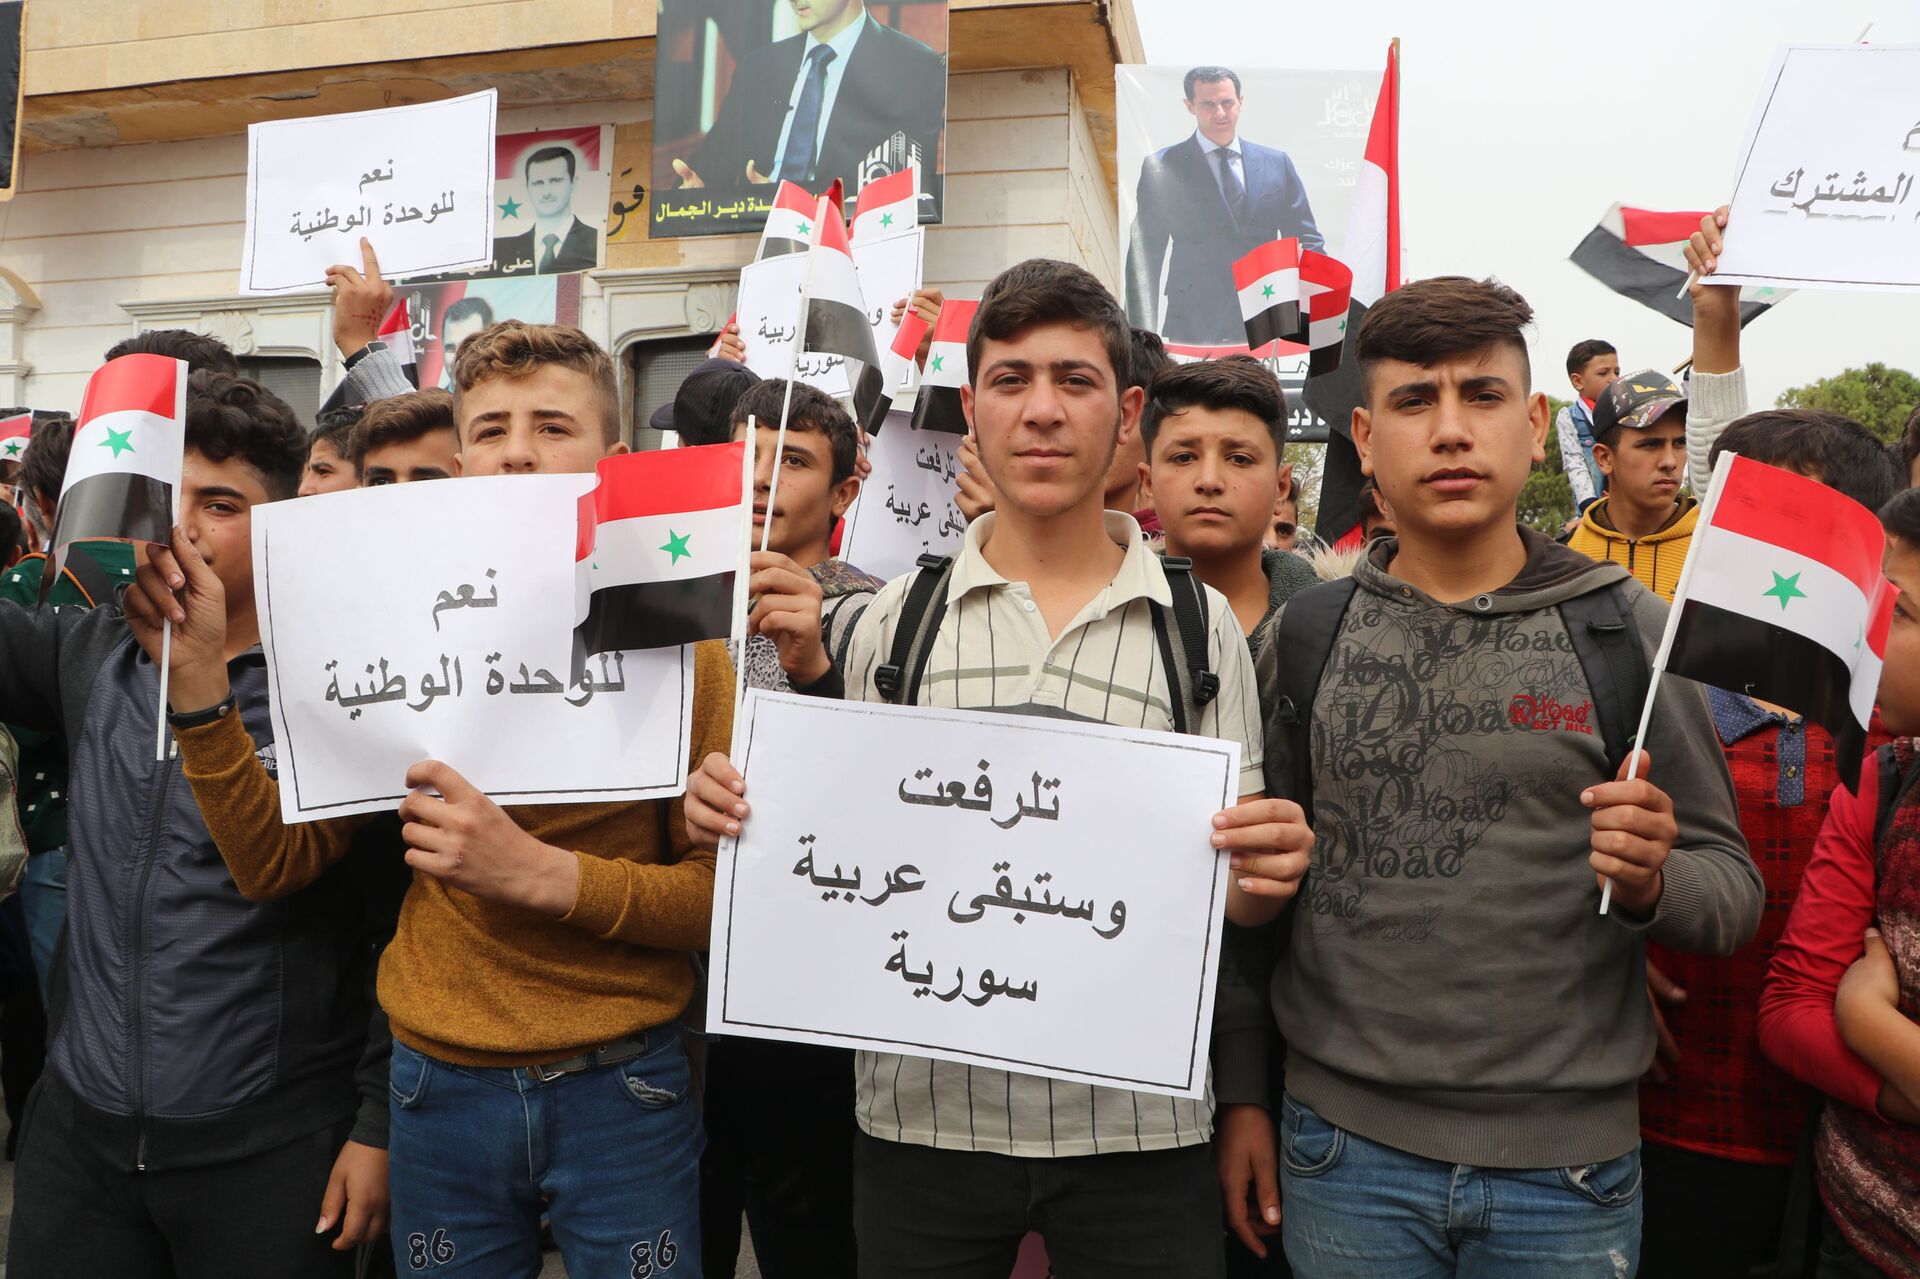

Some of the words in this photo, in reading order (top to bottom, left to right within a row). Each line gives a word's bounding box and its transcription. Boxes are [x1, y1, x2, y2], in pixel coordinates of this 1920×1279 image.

[358, 158, 394, 195] نعم
[1770, 167, 1915, 213] المشترك
[289, 205, 371, 243] الوطنية
[383, 190, 455, 226] للوحدة
[655, 199, 712, 223] الجمال
[714, 198, 745, 220] دير
[502, 257, 534, 274] على
[758, 315, 796, 345] ربية
[885, 484, 931, 527] عربية
[432, 568, 498, 632] نعم
[324, 654, 462, 721] الوطنية
[485, 650, 626, 707] للوحدة
[899, 759, 1061, 829] تلرفعت
[792, 833, 926, 907] عربية
[948, 861, 1127, 940] وستبقى
[884, 930, 1038, 1008] سورية
[408, 1228, 455, 1270] 86
[630, 1229, 677, 1279] 86
